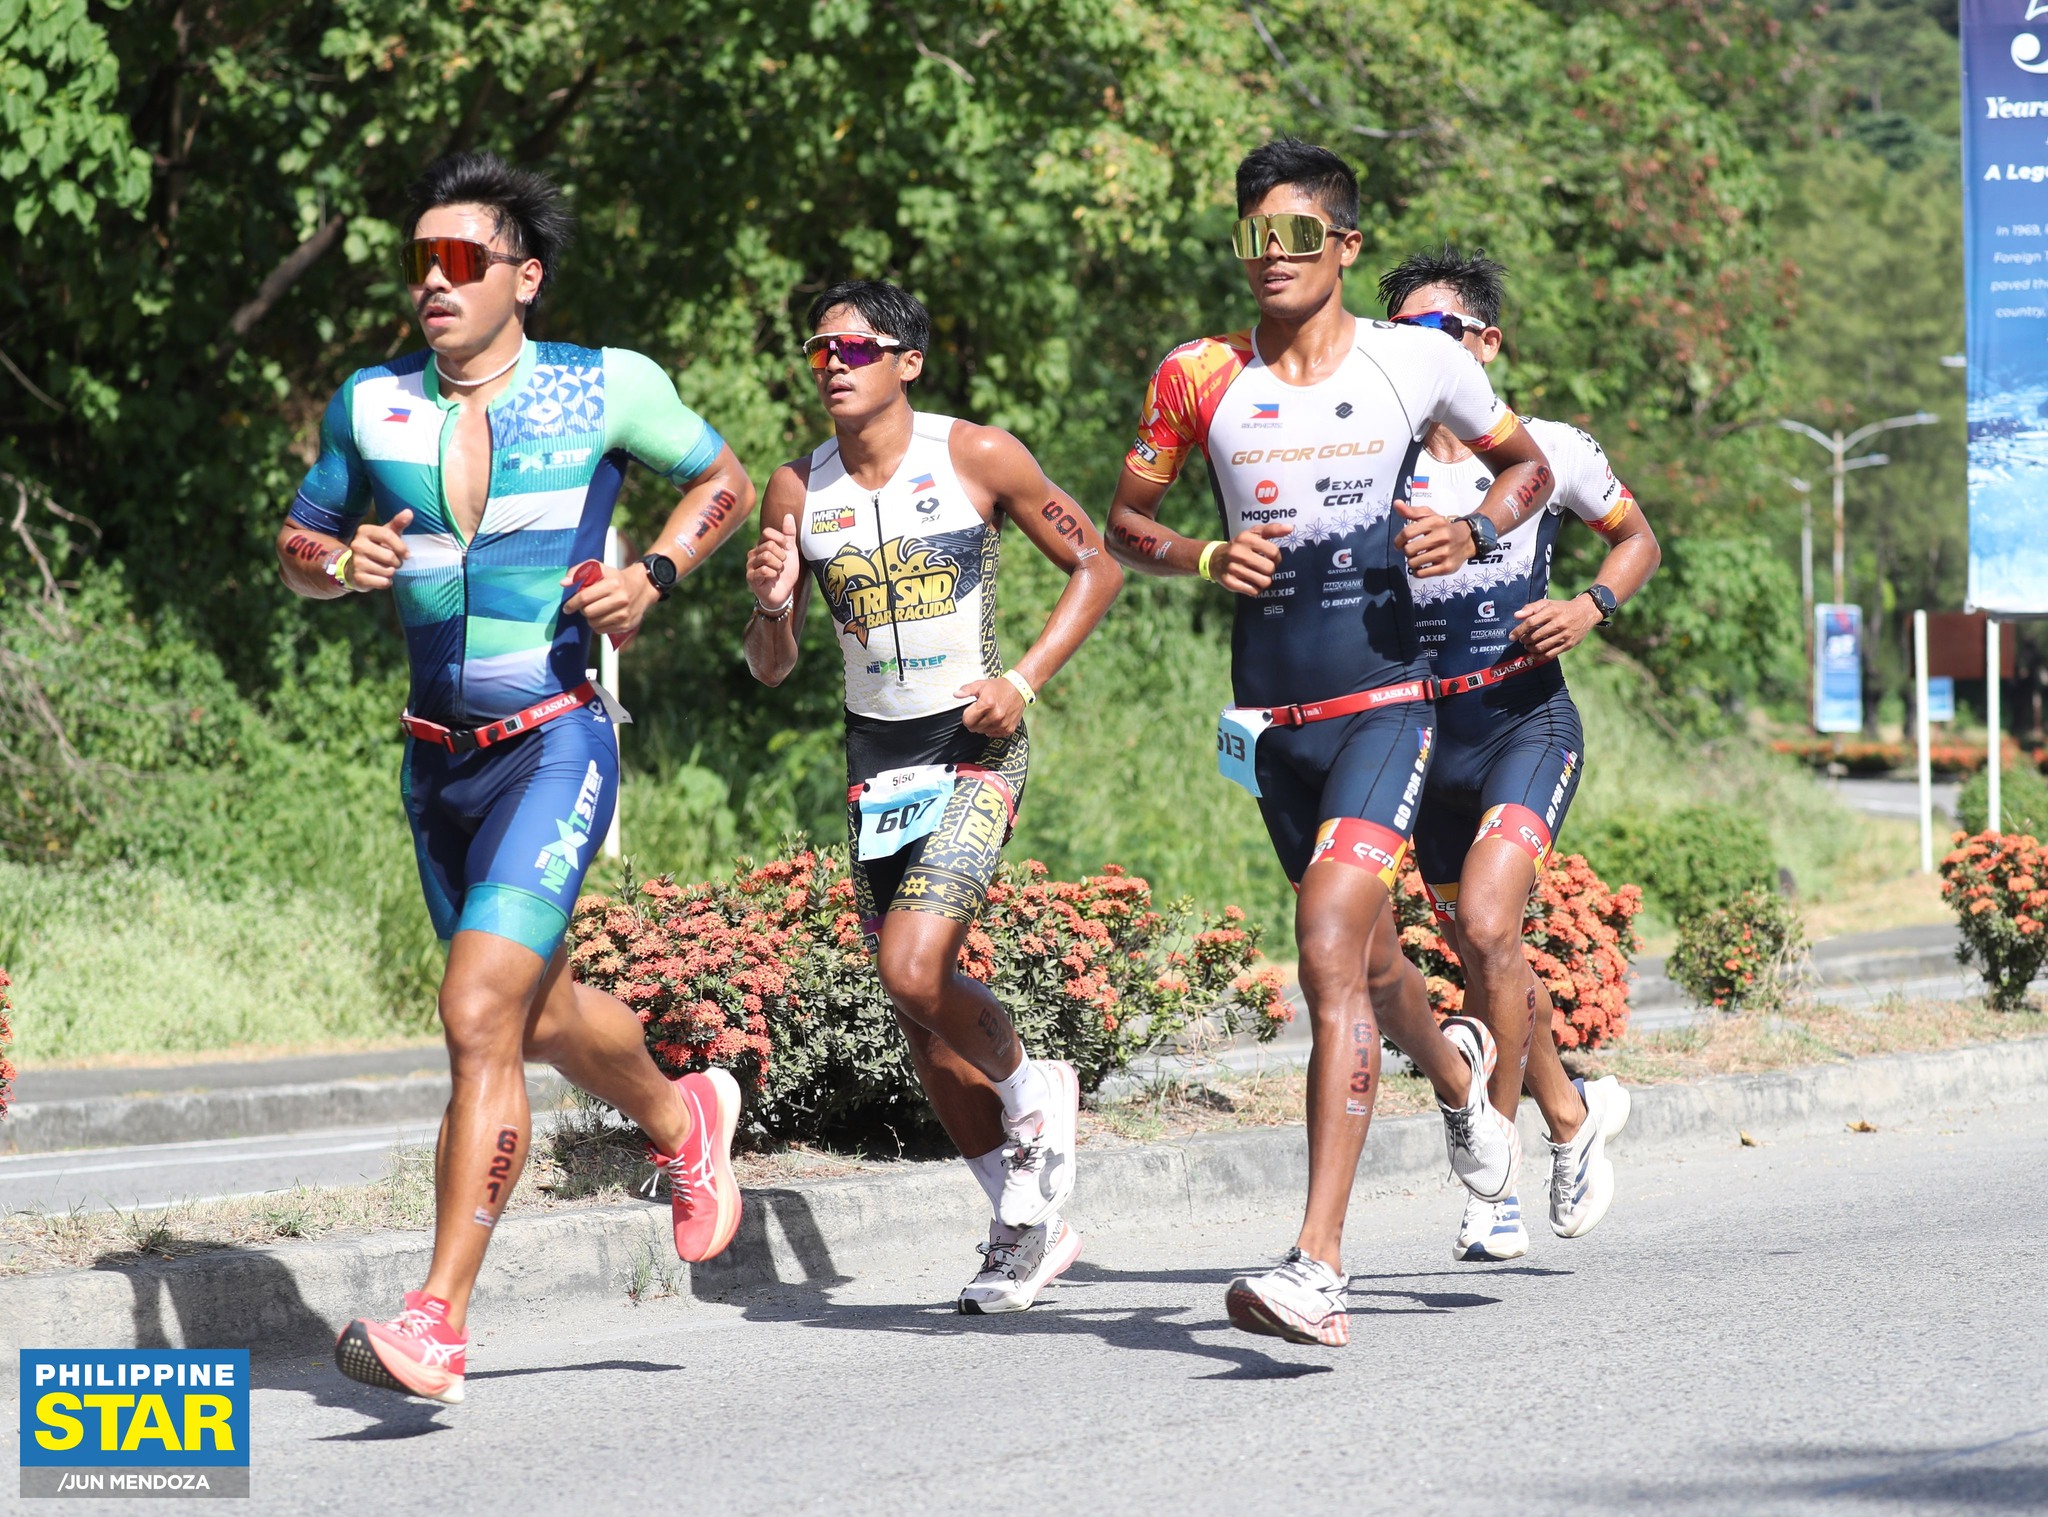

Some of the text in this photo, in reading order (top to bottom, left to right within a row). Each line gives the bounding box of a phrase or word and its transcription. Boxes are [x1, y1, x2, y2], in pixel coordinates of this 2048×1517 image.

[1984, 164, 2001, 181] A
[1993, 251, 2042, 266] Foreign
[1990, 279, 2031, 293] paved
[1231, 439, 1385, 466] GO FOR GOLD
[1331, 478, 1374, 491] EXAR
[813, 509, 841, 523] WHEY
[1041, 500, 1086, 547] 607
[1241, 508, 1298, 523] Magene
[1327, 567, 1358, 575] GATORADE
[848, 573, 953, 618] TRI SND
[866, 599, 956, 629] BARRACUDA
[1419, 633, 1447, 643] AXXIS
[1492, 662, 1528, 679] ALASKA
[1370, 687, 1412, 703] ALASKA
[1393, 804, 1412, 831] GO
[1403, 772, 1422, 807] FOR
[1545, 805, 1556, 828] GO
[1552, 783, 1565, 811] FOR
[876, 797, 938, 834] 607
[534, 850, 551, 870] THE
[1350, 1023, 1373, 1093] 613
[488, 1129, 518, 1204] 621
